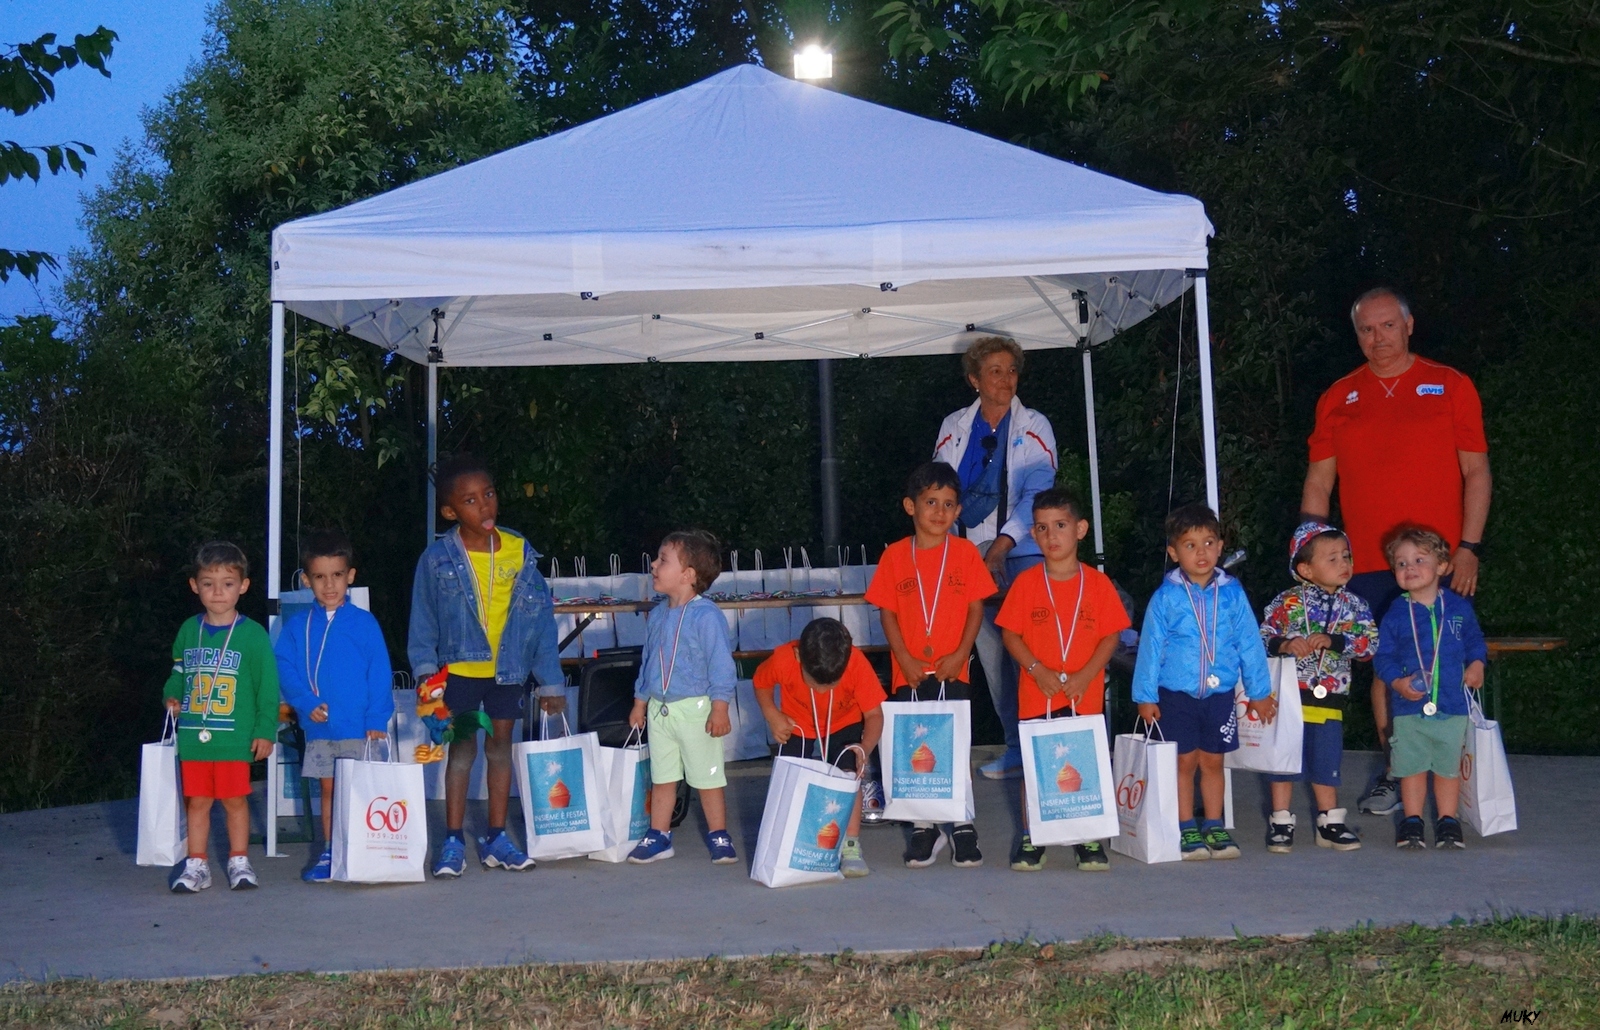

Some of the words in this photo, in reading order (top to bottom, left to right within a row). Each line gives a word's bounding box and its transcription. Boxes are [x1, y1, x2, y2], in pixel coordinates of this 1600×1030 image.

[1420, 386, 1443, 394] AVIS
[184, 647, 242, 670] CHICAGO
[189, 673, 237, 716] 23
[922, 776, 927, 784] È
[1041, 798, 1070, 807] INSIEME
[1078, 794, 1100, 803] FESTA!
[534, 812, 559, 821] INSIEME
[561, 811, 566, 820] È
[566, 810, 586, 818] FESTA!
[794, 848, 823, 860] INSIEME
